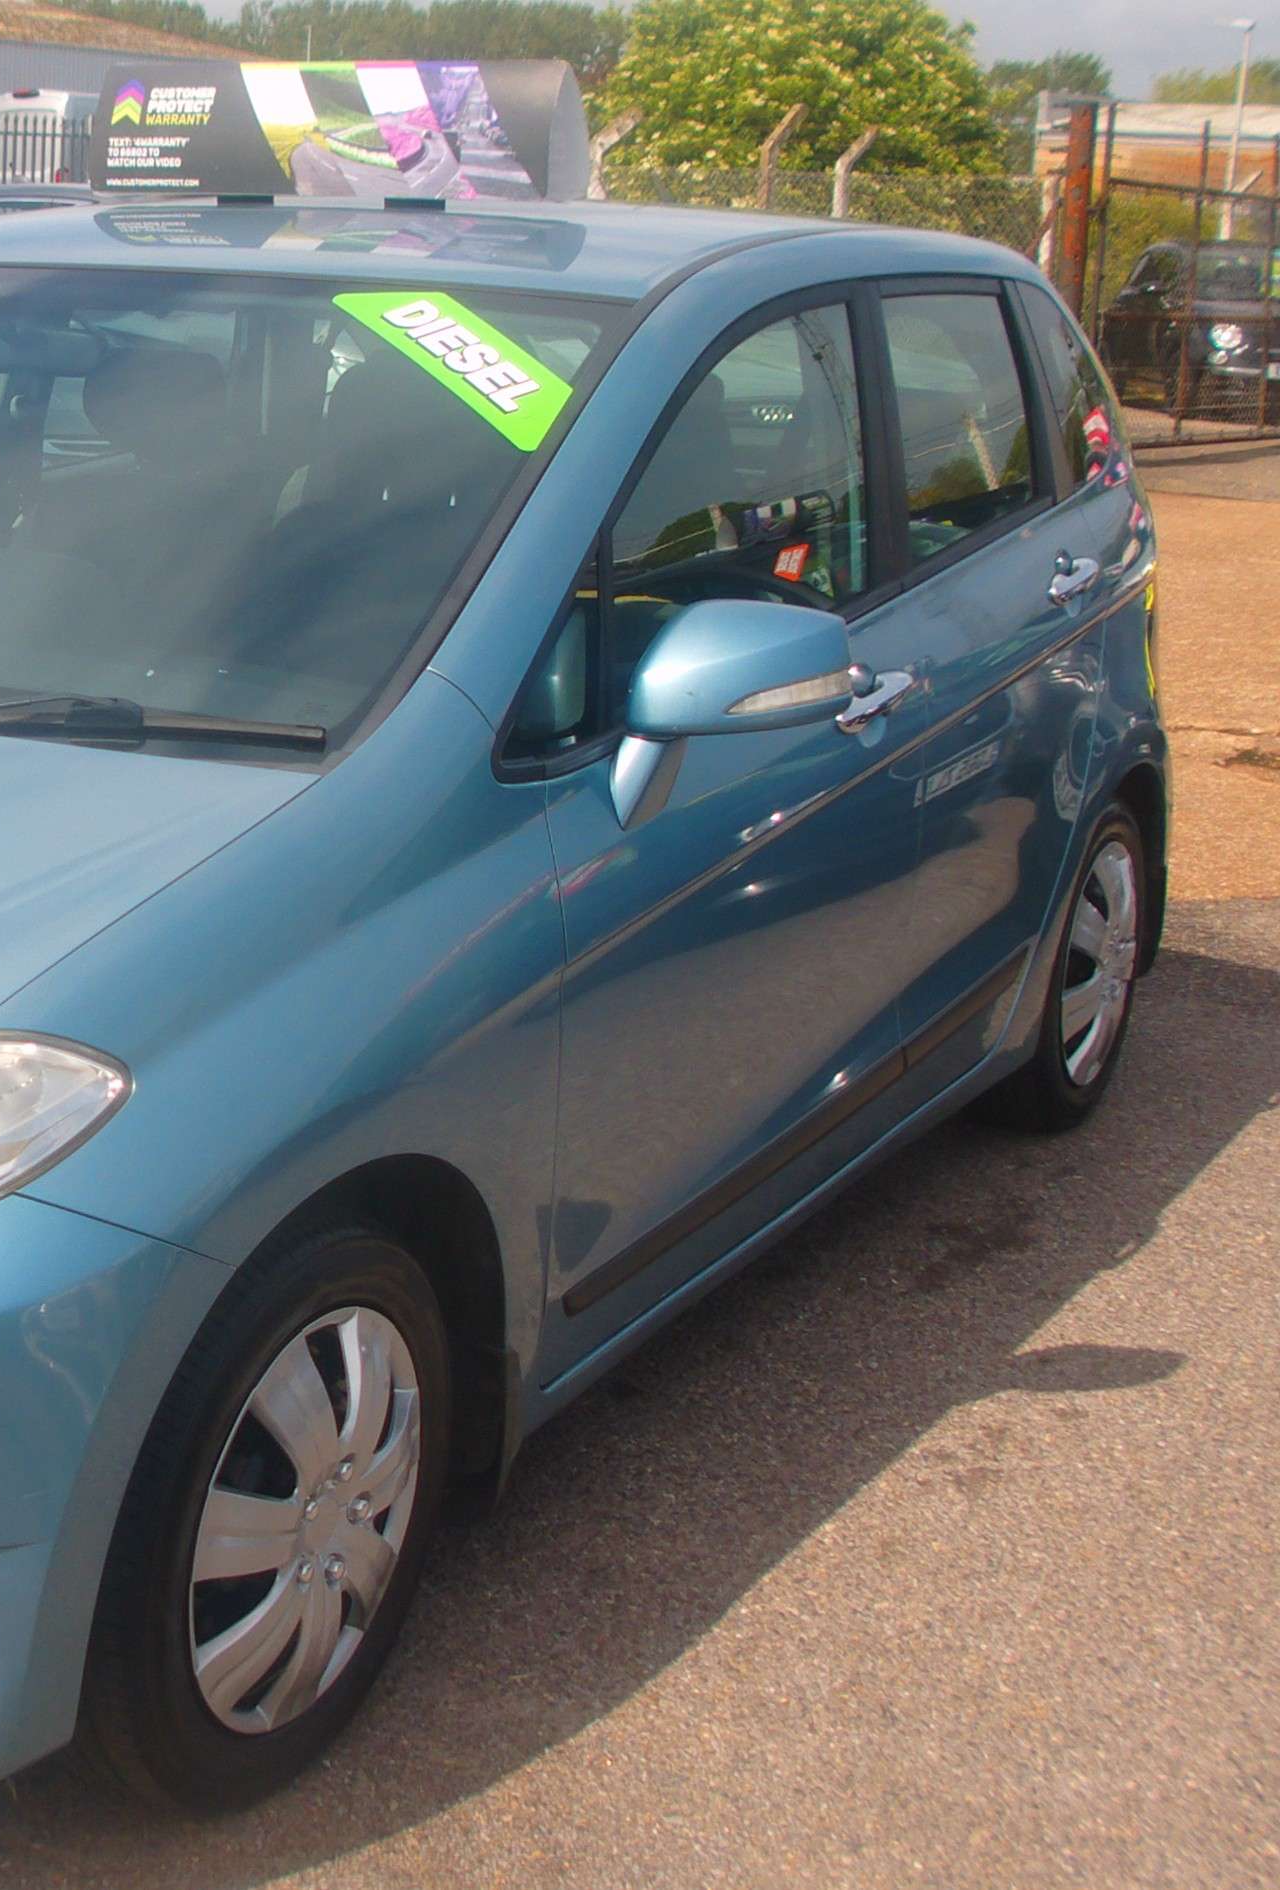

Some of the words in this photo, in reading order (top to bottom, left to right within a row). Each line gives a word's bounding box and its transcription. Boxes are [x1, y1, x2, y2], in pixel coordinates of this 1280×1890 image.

[149, 87, 217, 100] CUSTOMER
[147, 99, 214, 113] PROTECT
[145, 113, 211, 126] WARRANTY
[108, 147, 119, 157] TO
[148, 147, 160, 157] TO
[106, 157, 136, 168] WATCH
[136, 157, 155, 168] OUR
[155, 157, 182, 168] VIDEO
[380, 299, 541, 415] DIESEL
